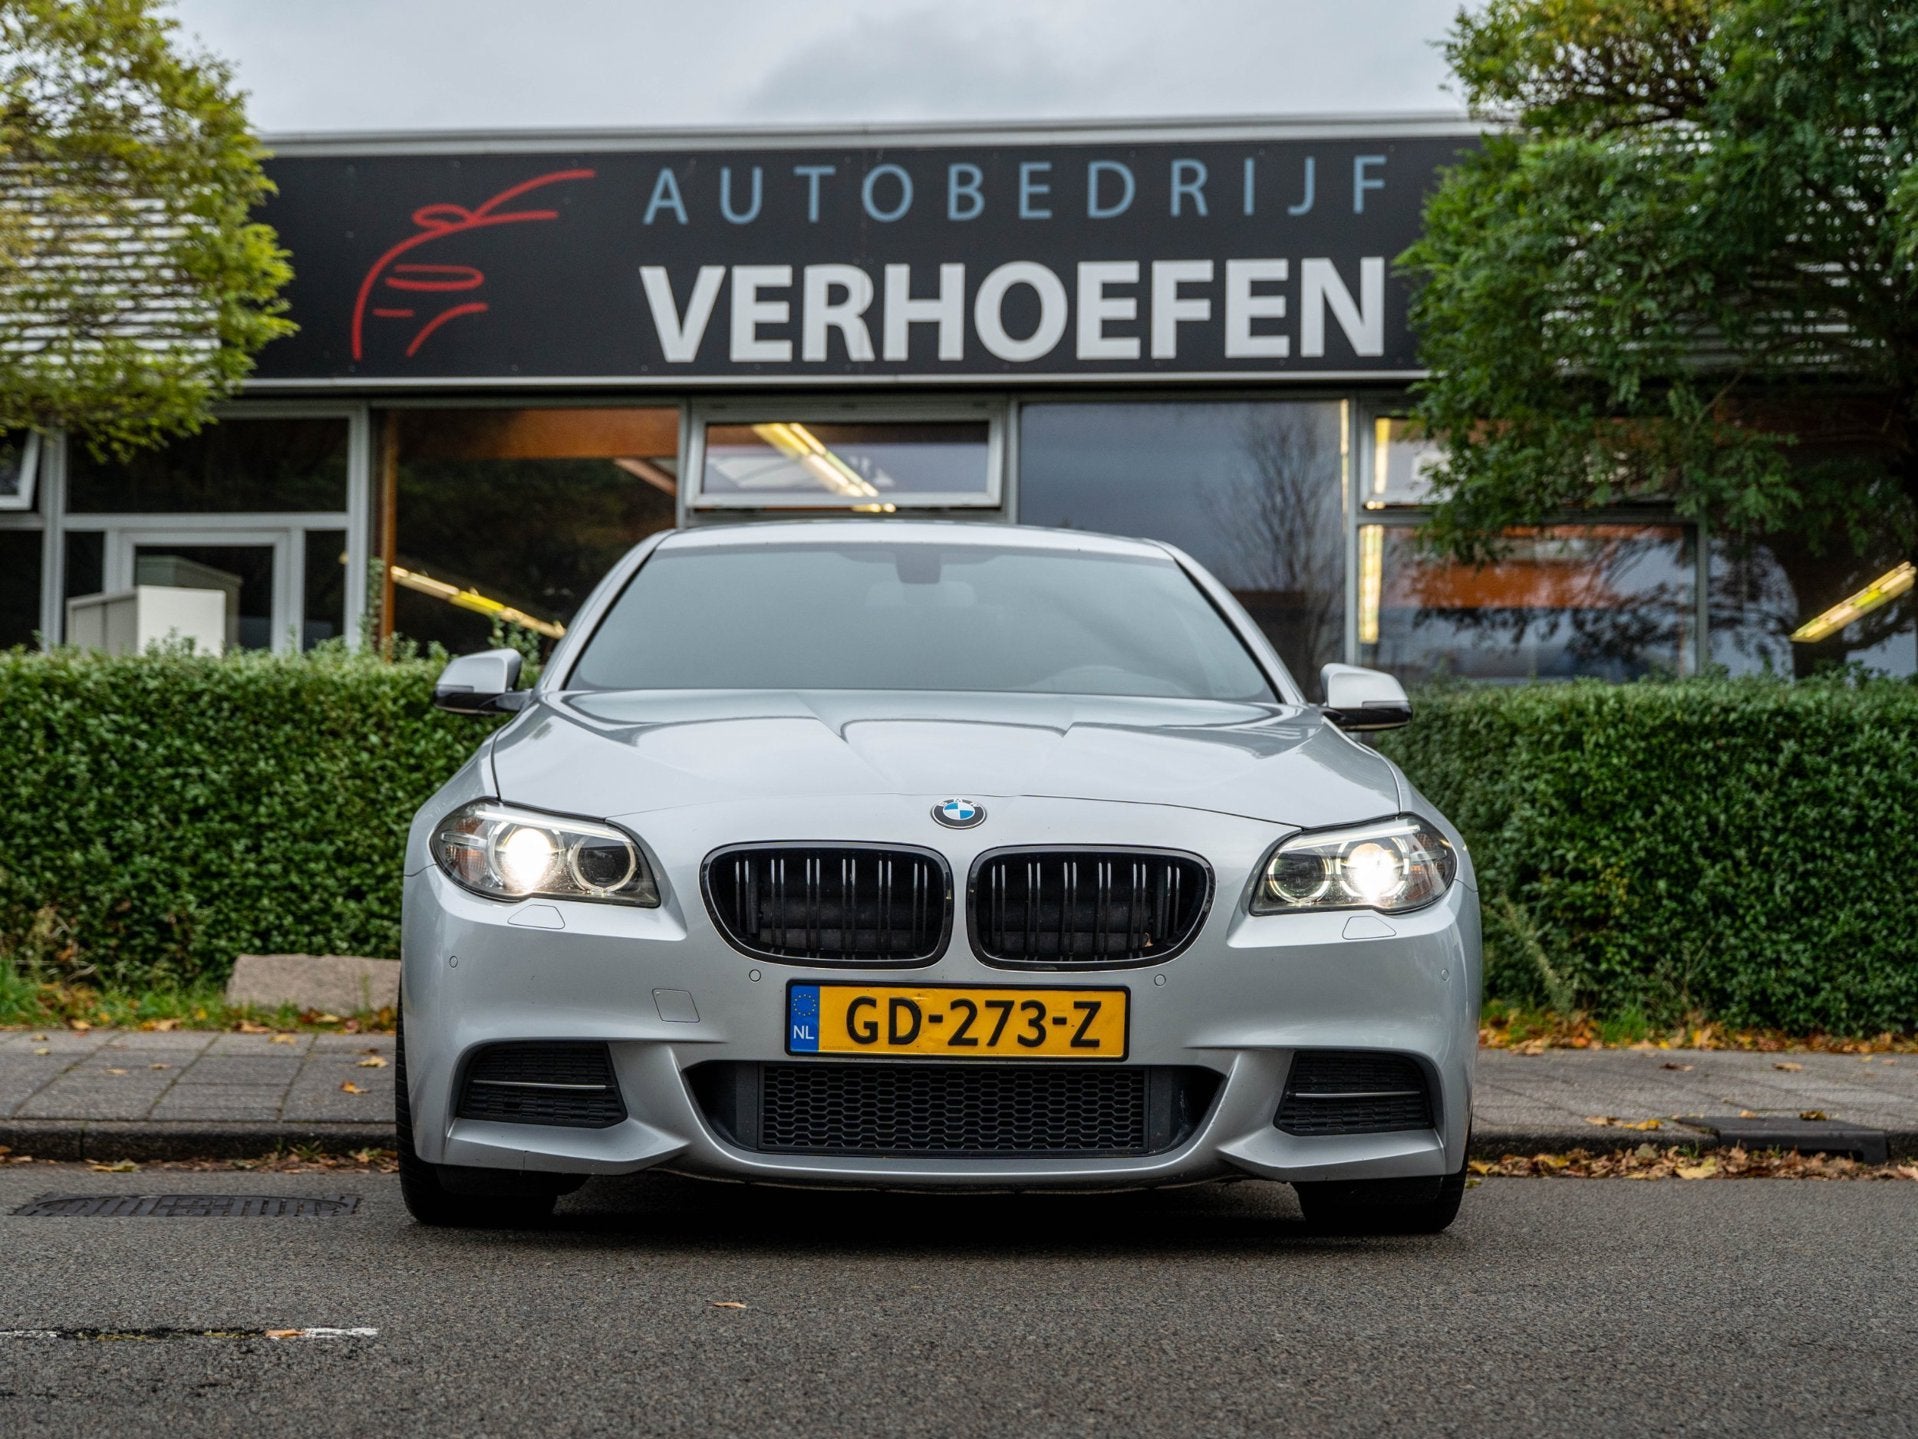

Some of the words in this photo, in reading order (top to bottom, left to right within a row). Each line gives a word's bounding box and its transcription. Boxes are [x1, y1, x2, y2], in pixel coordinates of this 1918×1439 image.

[643, 155, 1387, 225] AUTOBEDRIJF
[639, 256, 1385, 363] VERHOEFEN
[793, 1025, 815, 1040] NL
[846, 995, 1102, 1049] GD-273-Z
